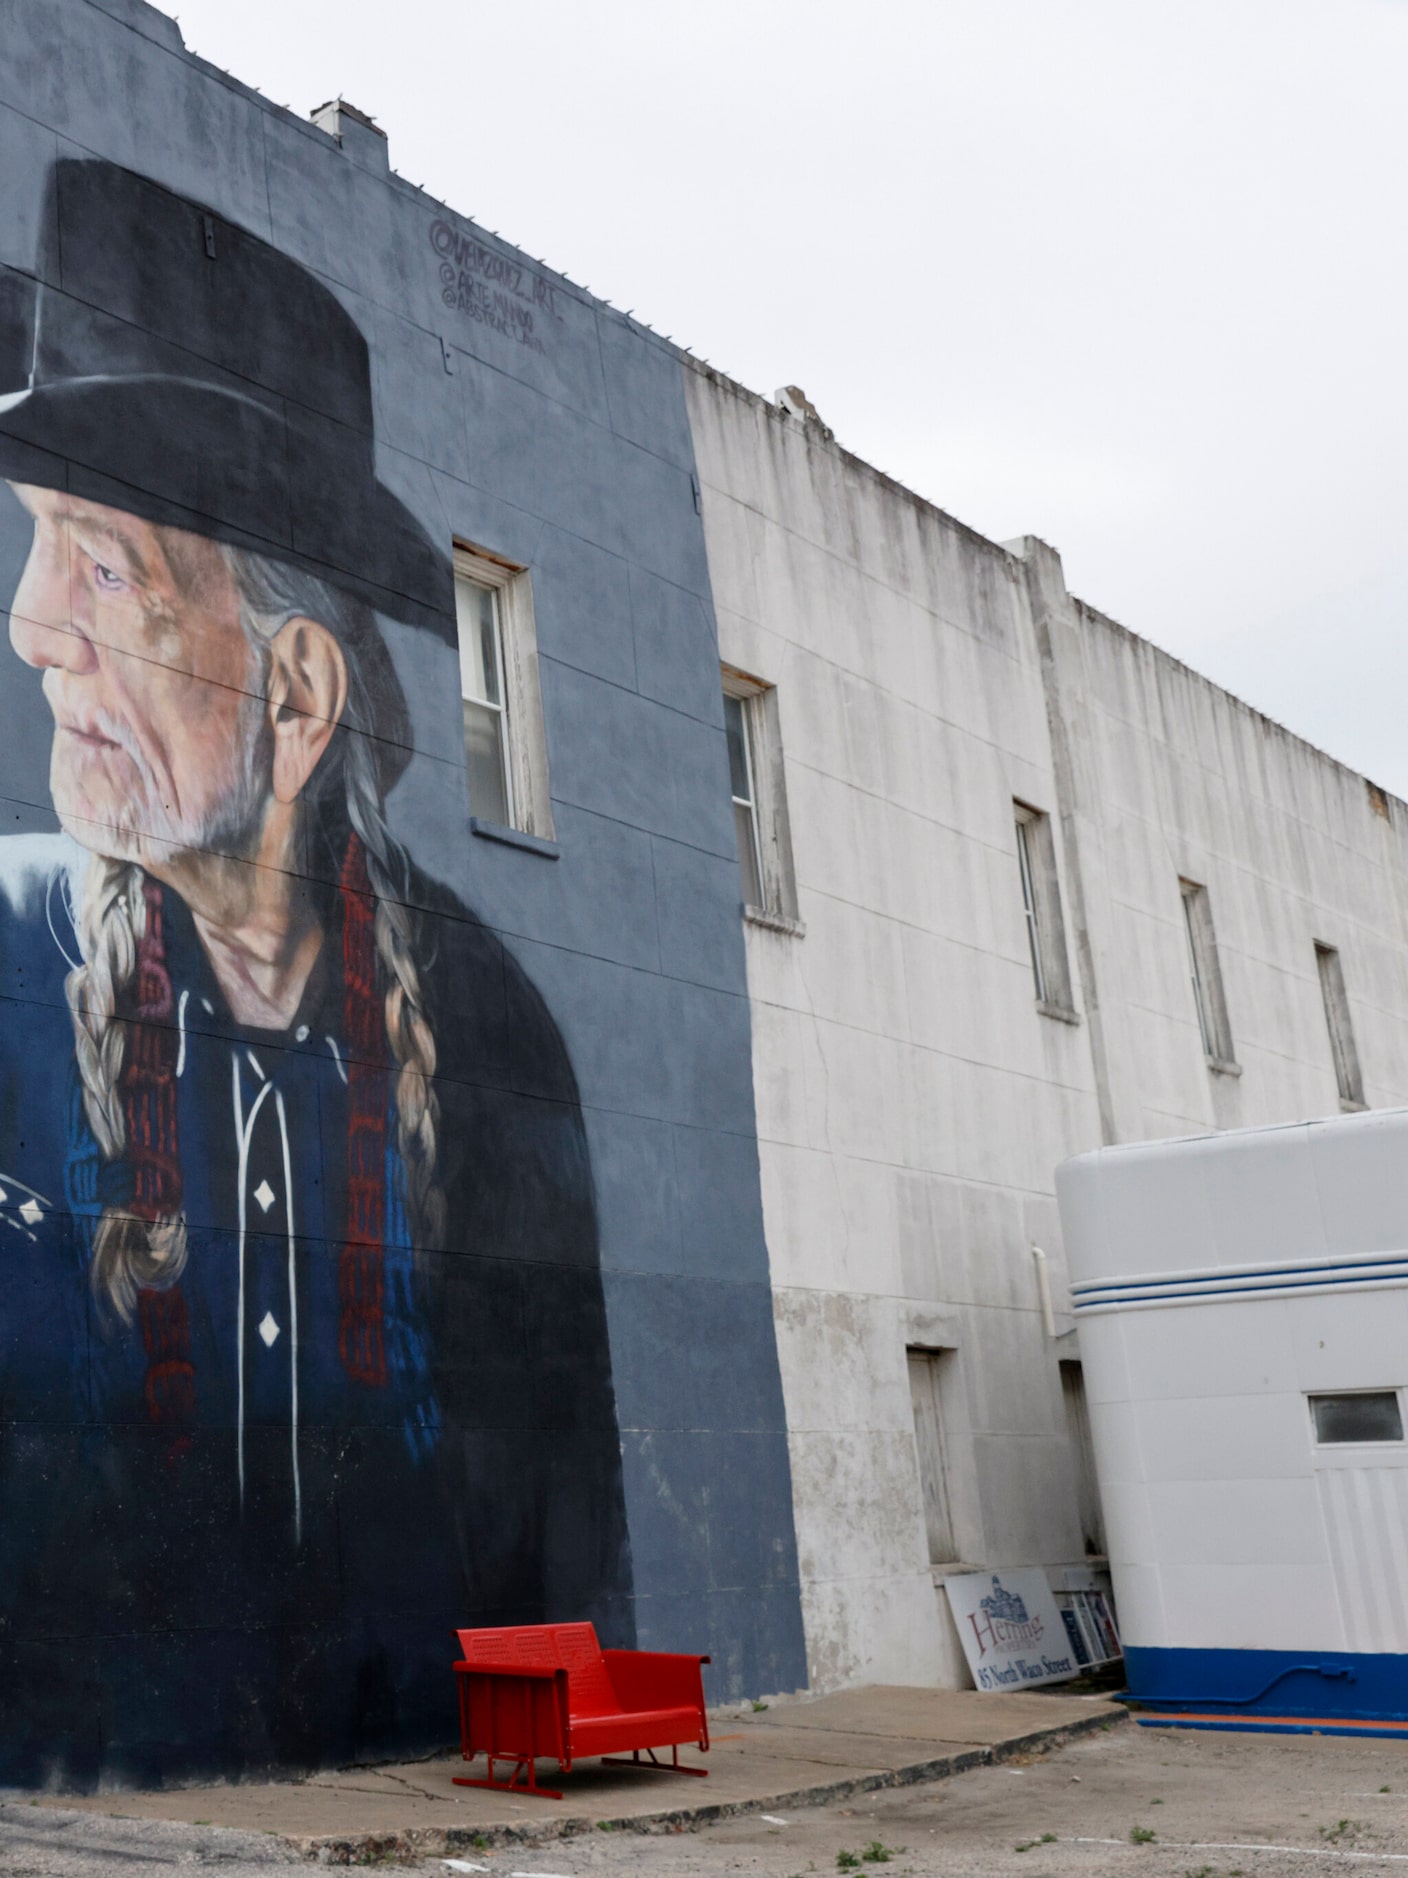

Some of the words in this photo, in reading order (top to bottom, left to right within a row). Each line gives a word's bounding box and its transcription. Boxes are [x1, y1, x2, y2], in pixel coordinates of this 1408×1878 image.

[992, 1660, 1019, 1686] North
[1016, 1657, 1043, 1679] Waco
[1041, 1655, 1072, 1675] Street
